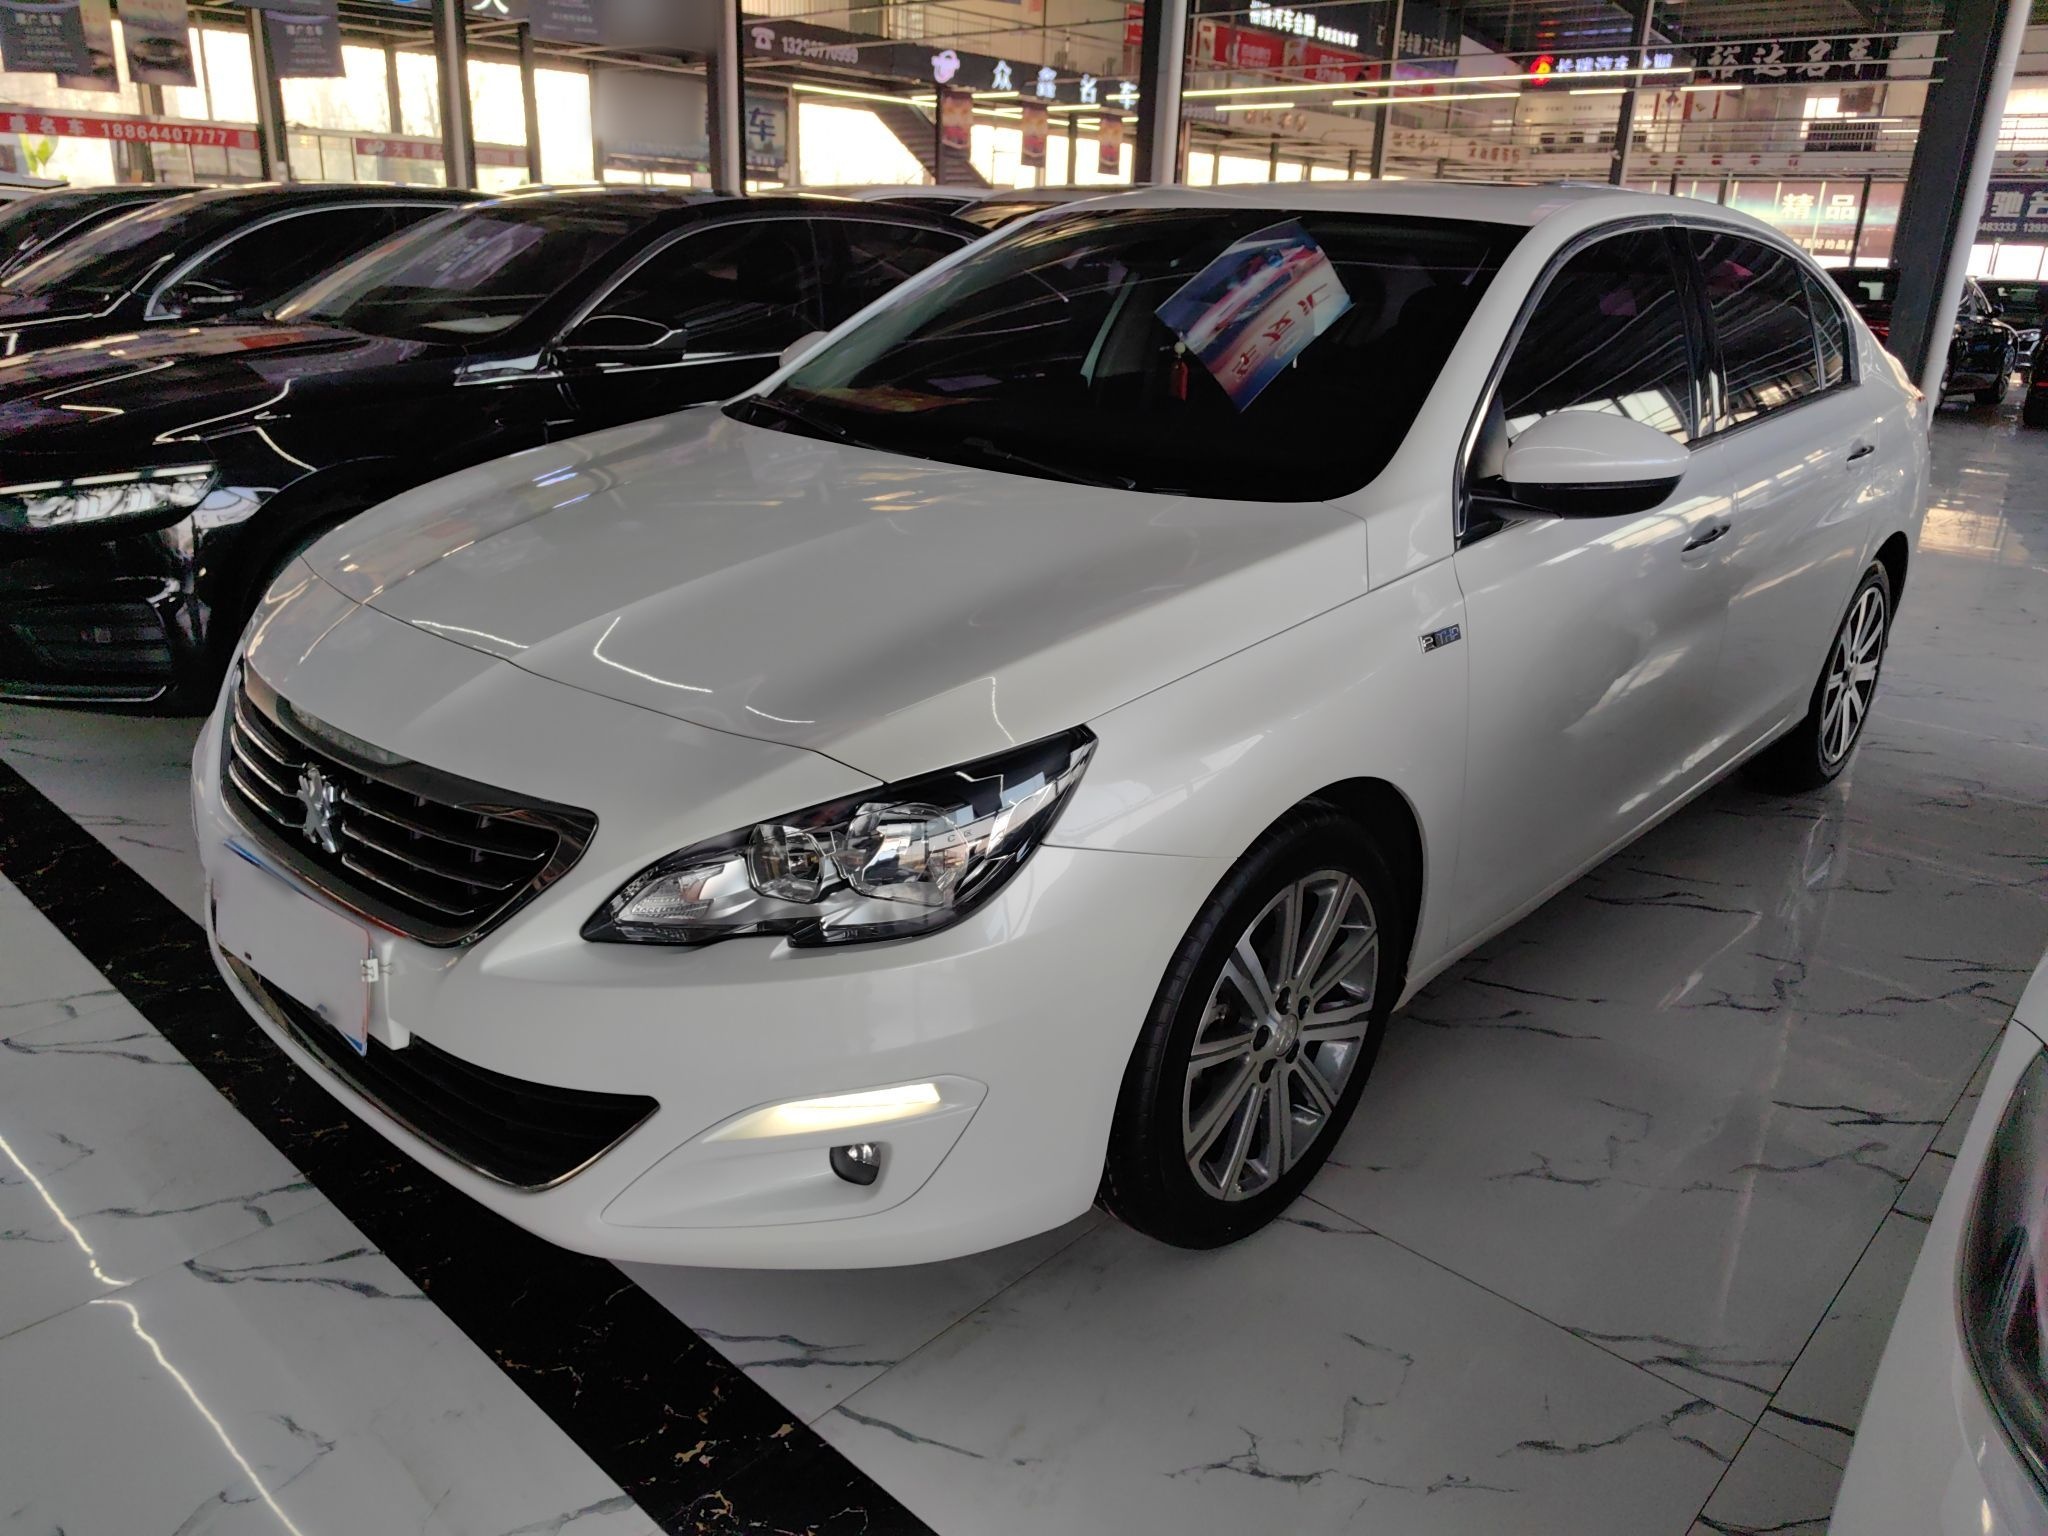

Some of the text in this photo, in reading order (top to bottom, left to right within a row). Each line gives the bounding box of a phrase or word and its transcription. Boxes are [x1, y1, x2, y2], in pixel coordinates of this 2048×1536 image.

[1707, 39, 1875, 79] 裕达名车
[101, 123, 227, 144] 18864407777
[1782, 193, 1857, 220] 精品
